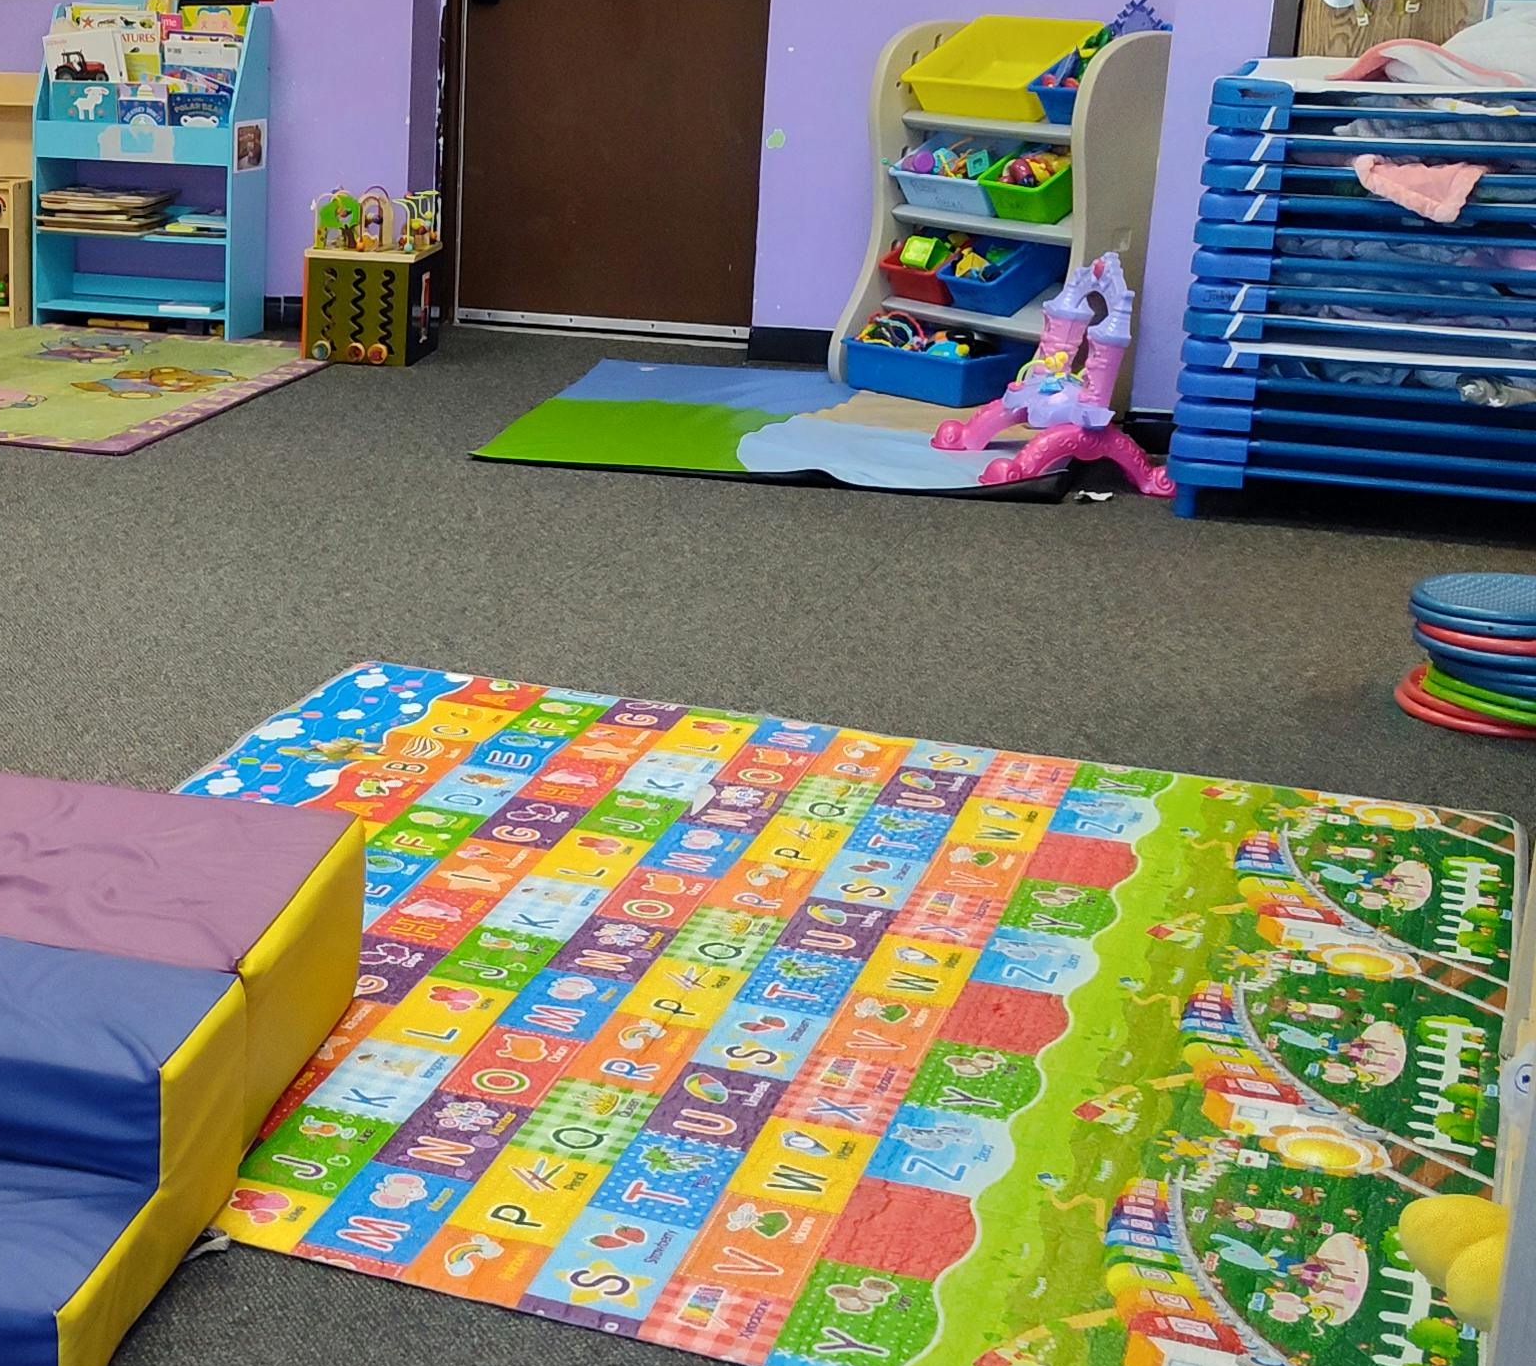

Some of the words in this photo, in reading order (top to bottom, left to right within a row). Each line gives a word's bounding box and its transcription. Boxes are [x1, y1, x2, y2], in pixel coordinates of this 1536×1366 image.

[164, 19, 177, 27] me
[433, 725, 469, 736] C
[384, 762, 428, 773] B
[487, 750, 533, 768] E
[927, 752, 970, 767] S
[738, 769, 783, 784] O
[1096, 776, 1147, 791] Y
[443, 793, 483, 806] D
[896, 791, 946, 809] U
[702, 808, 752, 827] N
[809, 802, 848, 818] Q
[493, 825, 541, 842] G
[600, 816, 645, 832] J
[974, 824, 1023, 841] W
[1076, 819, 1126, 835] Z
[393, 834, 435, 852] F
[662, 852, 716, 873] M
[733, 892, 784, 909] R
[839, 882, 888, 899] S
[622, 899, 674, 919] O
[388, 917, 445, 941] H
[512, 913, 560, 930] K
[1027, 912, 1084, 929] Y
[799, 929, 856, 951] U
[574, 949, 633, 972] N
[698, 942, 746, 961] Q
[458, 960, 508, 980] J
[1002, 963, 1059, 985] Z
[883, 969, 940, 992] W
[764, 982, 820, 1001] T
[653, 997, 696, 1016] P
[524, 1005, 586, 1032] M
[402, 1027, 460, 1043] L
[845, 1028, 908, 1051] V
[725, 1044, 779, 1066] S
[600, 1058, 661, 1081] R
[471, 1069, 531, 1094] O
[341, 1088, 398, 1108] K
[937, 1086, 1003, 1108] Y
[617, 1097, 641, 1118] Queen
[807, 1096, 871, 1124] X
[673, 1108, 738, 1135] U
[551, 1126, 610, 1150] Q
[406, 1136, 476, 1167] N
[272, 1153, 328, 1180] J
[902, 1155, 968, 1183] Z
[564, 1171, 589, 1191] Pencil
[762, 1163, 830, 1194] W
[622, 1180, 690, 1206] T
[488, 1203, 544, 1228] P
[336, 1215, 411, 1253] M
[644, 1229, 679, 1264] Strawberry
[713, 1246, 784, 1276] V
[568, 1267, 631, 1297] S
[814, 1327, 890, 1358] Y
